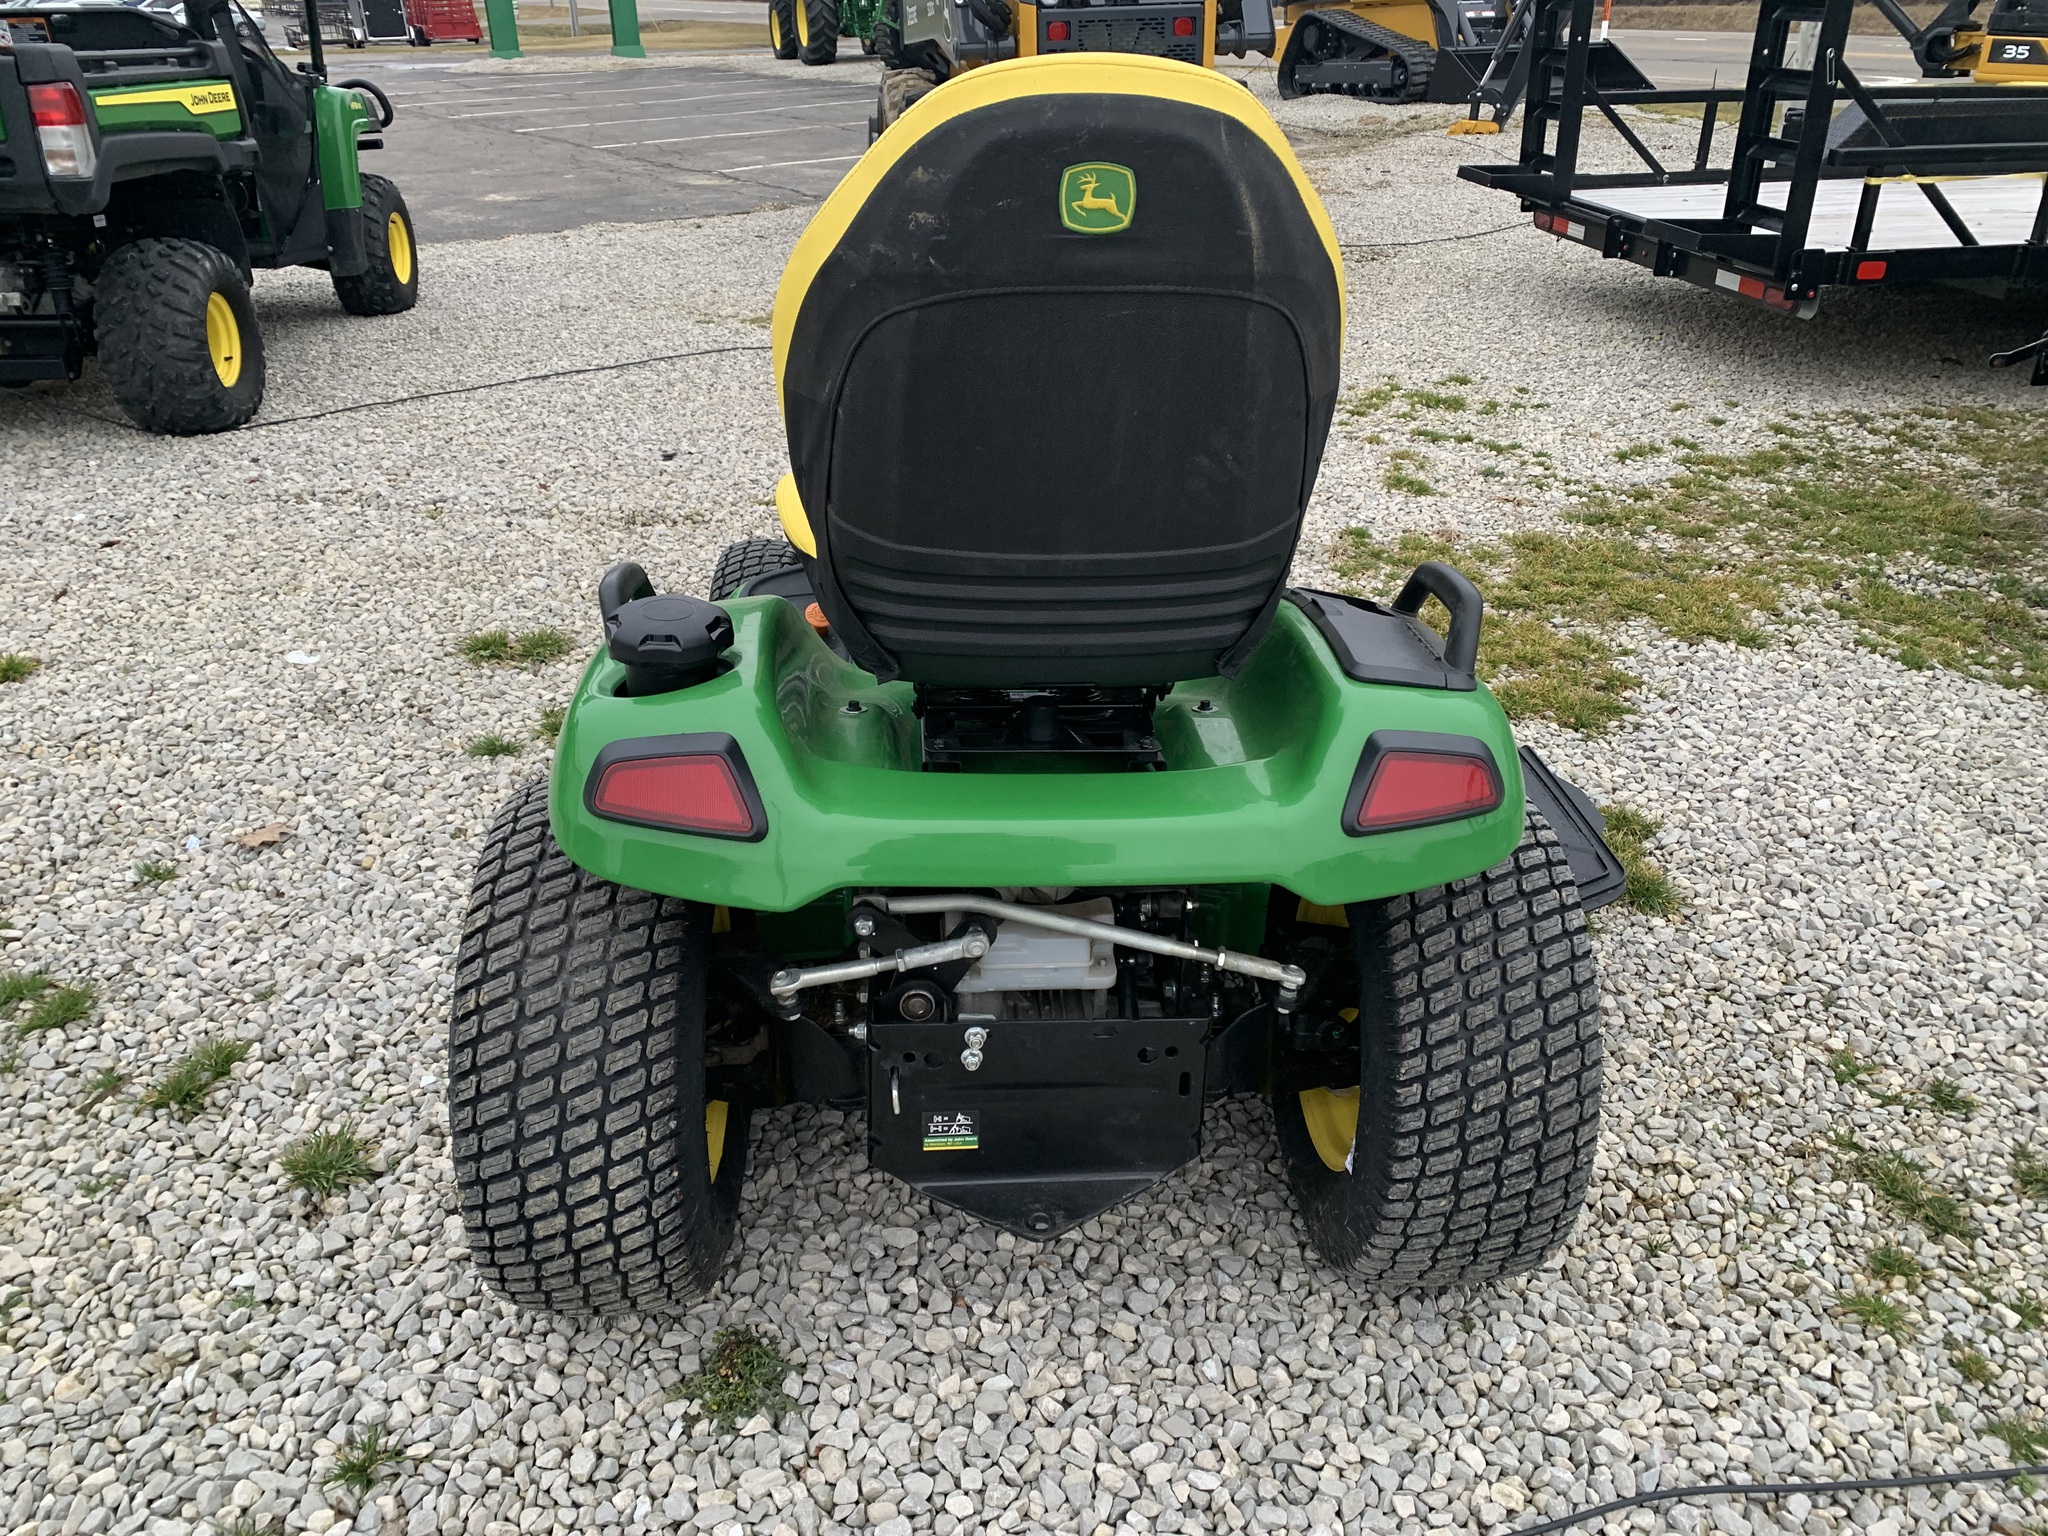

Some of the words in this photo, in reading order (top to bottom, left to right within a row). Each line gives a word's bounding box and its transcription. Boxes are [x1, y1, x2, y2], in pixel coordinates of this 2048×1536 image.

[2002, 44, 2031, 59] 35
[190, 93, 209, 106] JOHN
[207, 91, 231, 104] DEERE
